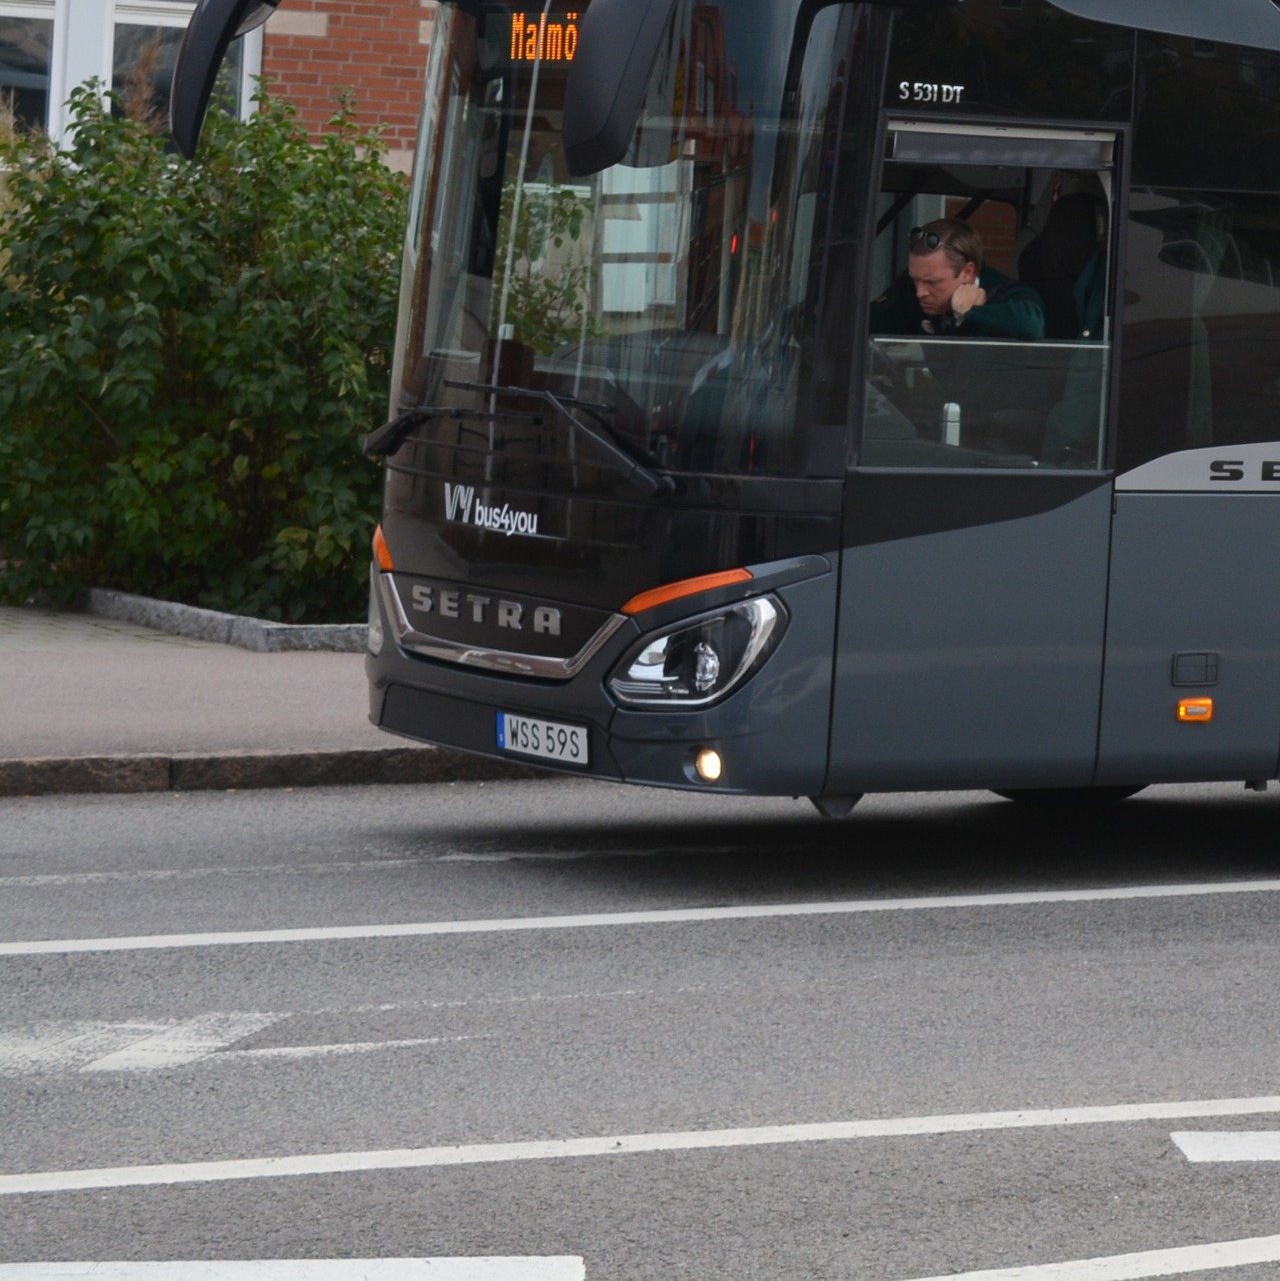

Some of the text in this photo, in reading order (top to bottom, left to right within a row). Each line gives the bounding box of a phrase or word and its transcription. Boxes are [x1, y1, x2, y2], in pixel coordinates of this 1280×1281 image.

[510, 12, 578, 60] Malmö
[899, 81, 965, 104] S 531 DT
[474, 498, 538, 536] bus4you
[411, 584, 561, 636] SETRA
[508, 718, 580, 758] WSS 59S
